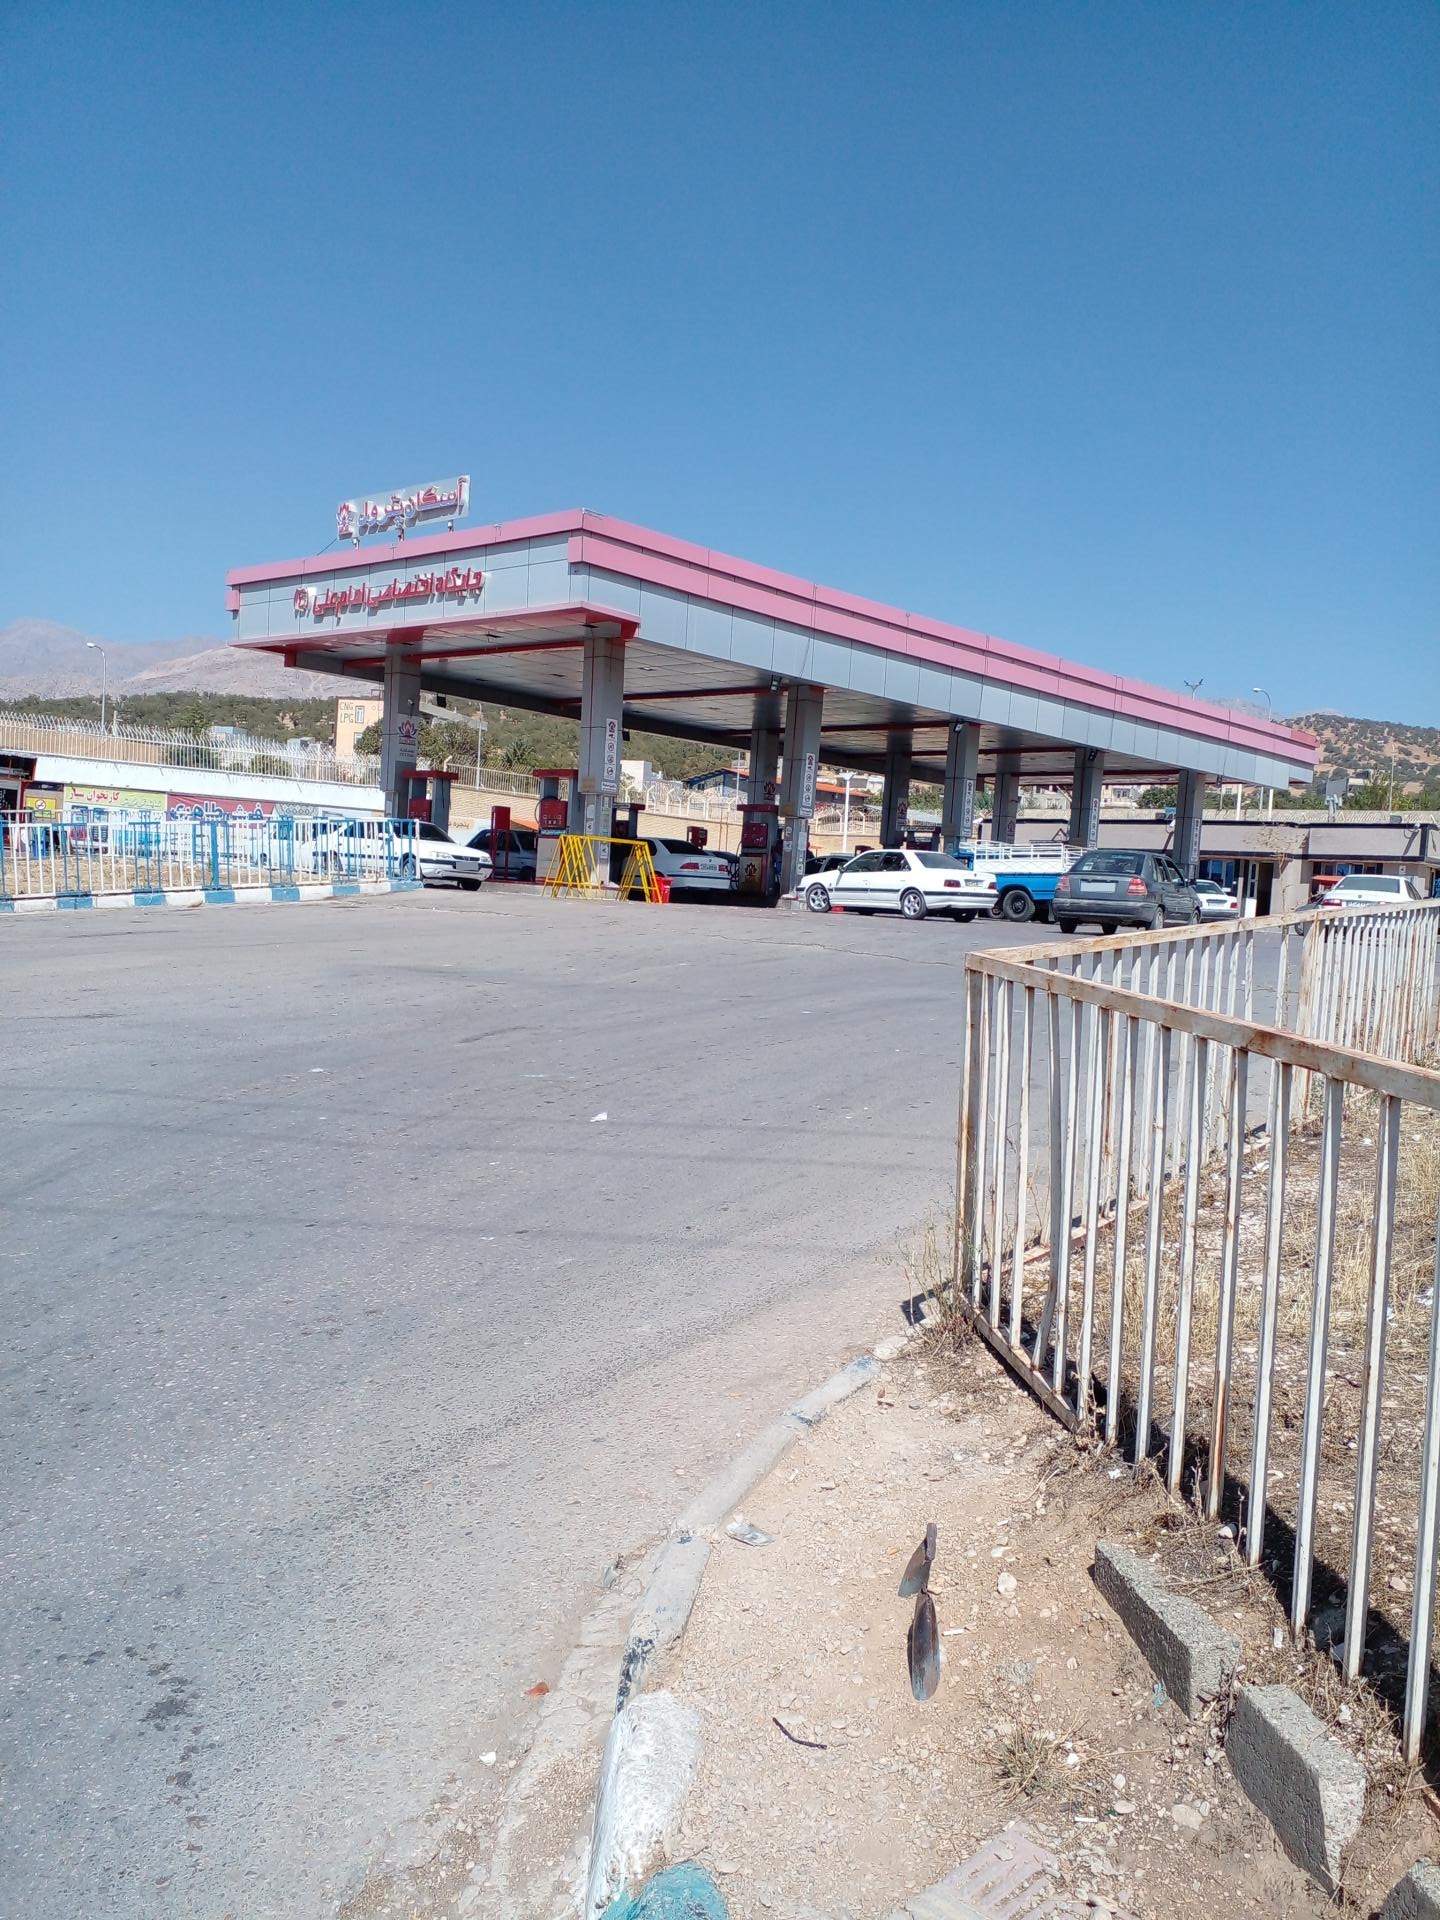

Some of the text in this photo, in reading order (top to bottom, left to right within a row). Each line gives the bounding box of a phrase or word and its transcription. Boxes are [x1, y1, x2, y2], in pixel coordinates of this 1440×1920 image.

[367, 571, 434, 608] اختصاصی
[436, 567, 484, 596] جایگاه
[312, 588, 336, 615] علی
[335, 583, 366, 618] امام
[339, 701, 354, 710] CNG
[339, 712, 354, 723] LPG
[86, 788, 120, 804] کارتخوان
